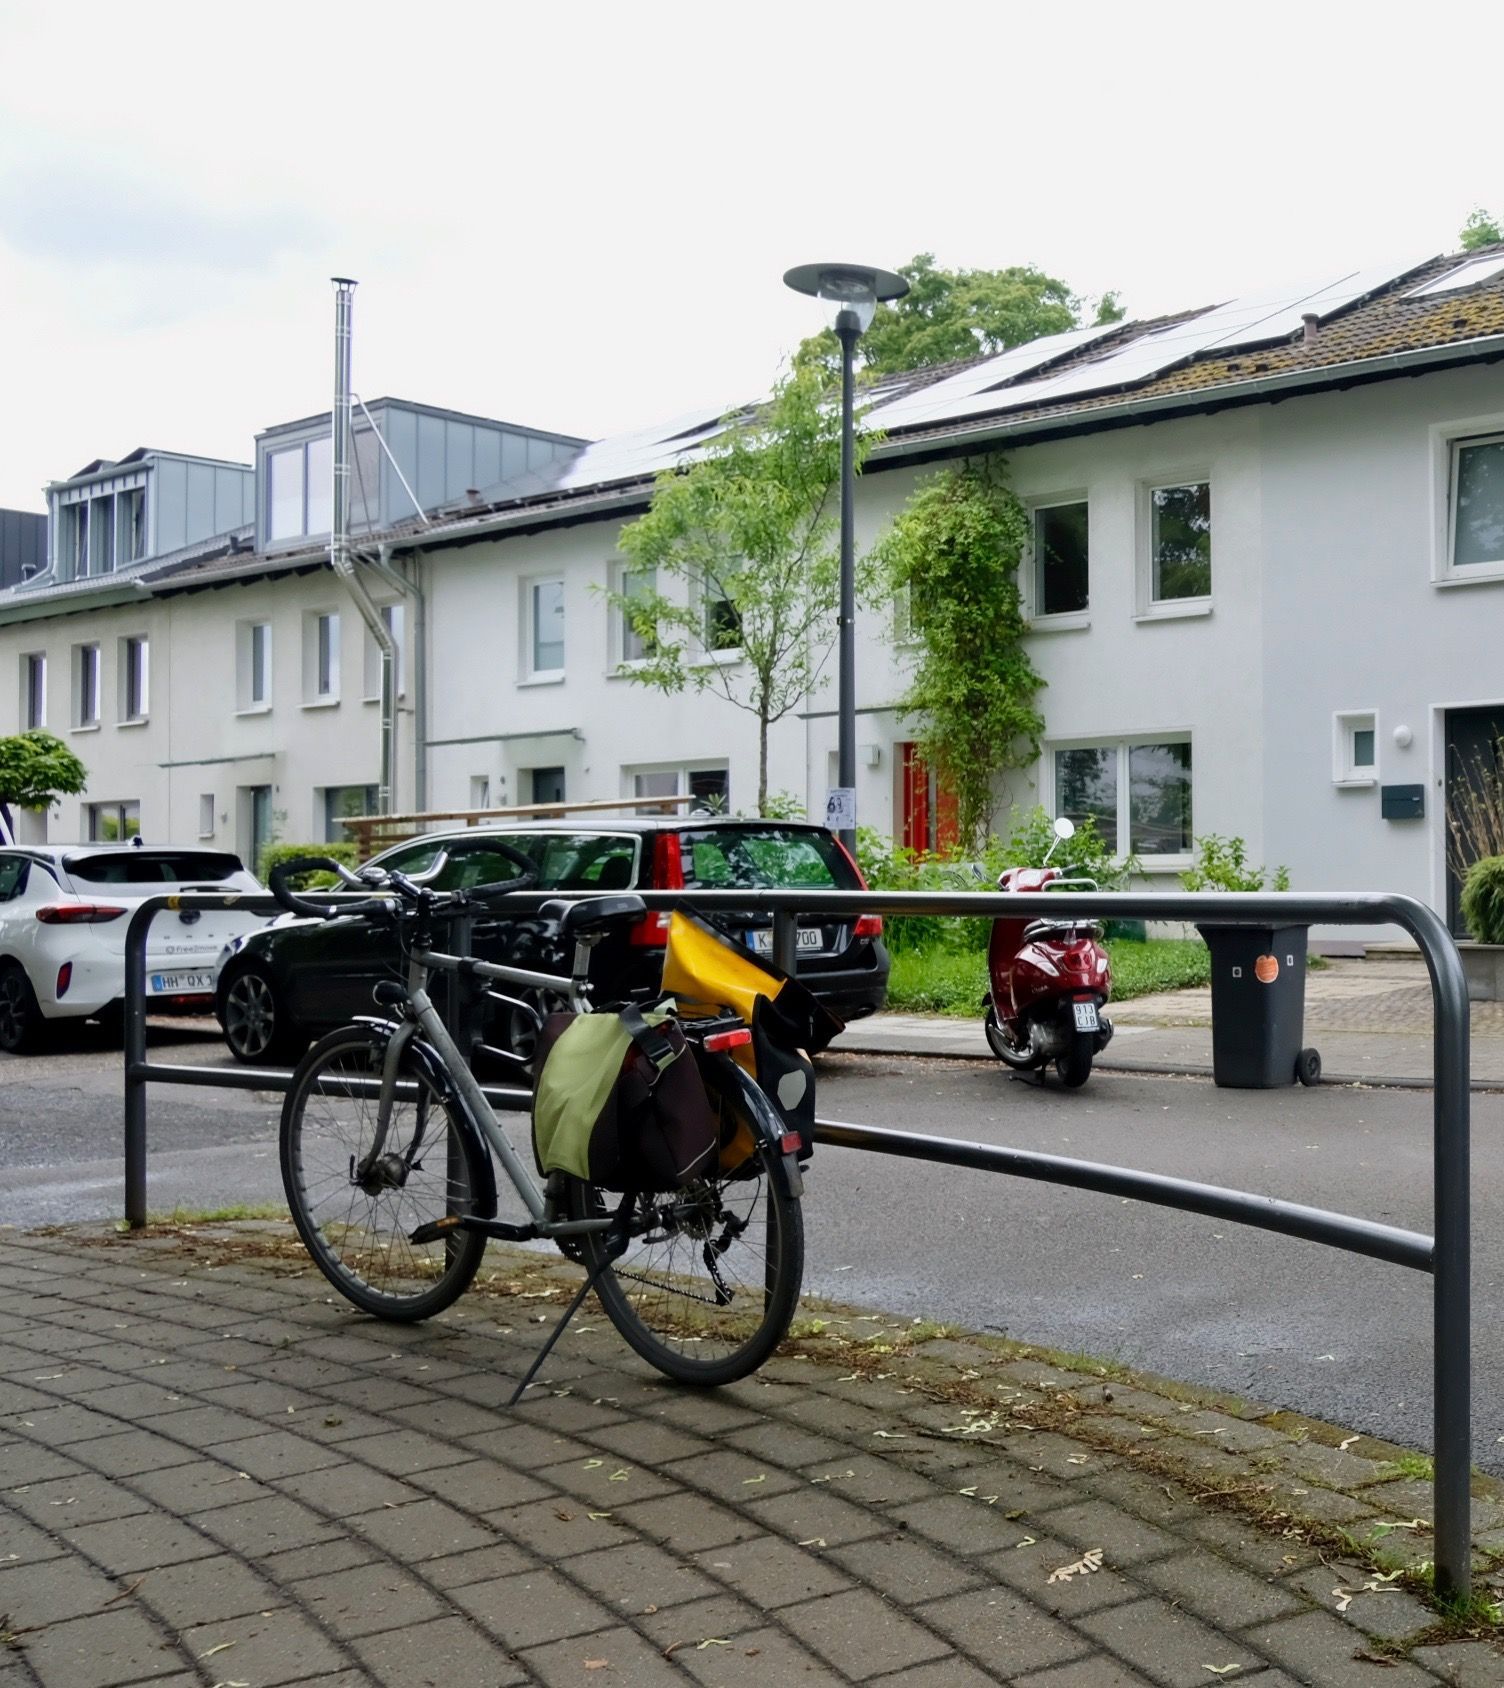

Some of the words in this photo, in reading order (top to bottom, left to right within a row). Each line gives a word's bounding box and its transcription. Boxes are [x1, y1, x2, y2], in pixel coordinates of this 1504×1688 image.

[758, 933, 768, 948] K
[162, 976, 179, 988] HH
[187, 975, 204, 987] QX
[1075, 1005, 1094, 1015] 913
